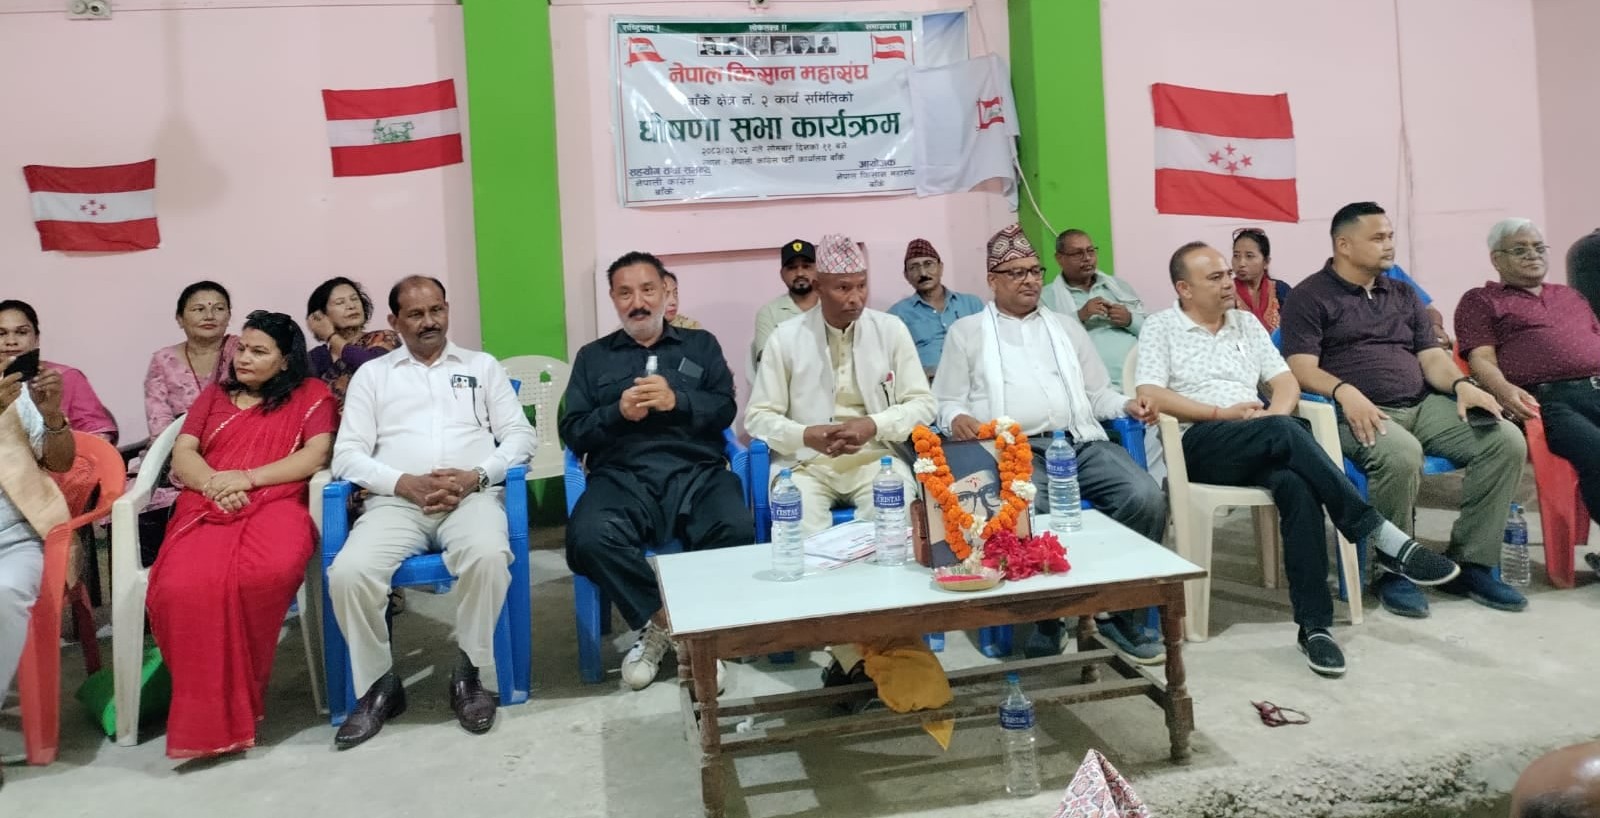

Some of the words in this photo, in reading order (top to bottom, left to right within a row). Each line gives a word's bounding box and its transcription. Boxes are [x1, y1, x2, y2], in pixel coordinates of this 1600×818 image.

[669, 62, 723, 84] नेपाल
[727, 61, 796, 85] किसान
[800, 61, 869, 84] महासंघ
[716, 93, 736, 107] क्षेत्र
[774, 92, 800, 105] कार्य
[804, 93, 853, 104] समितिको
[639, 111, 721, 143] घोषणा
[729, 116, 783, 143] सभा
[791, 109, 901, 138] कार्यक्रम
